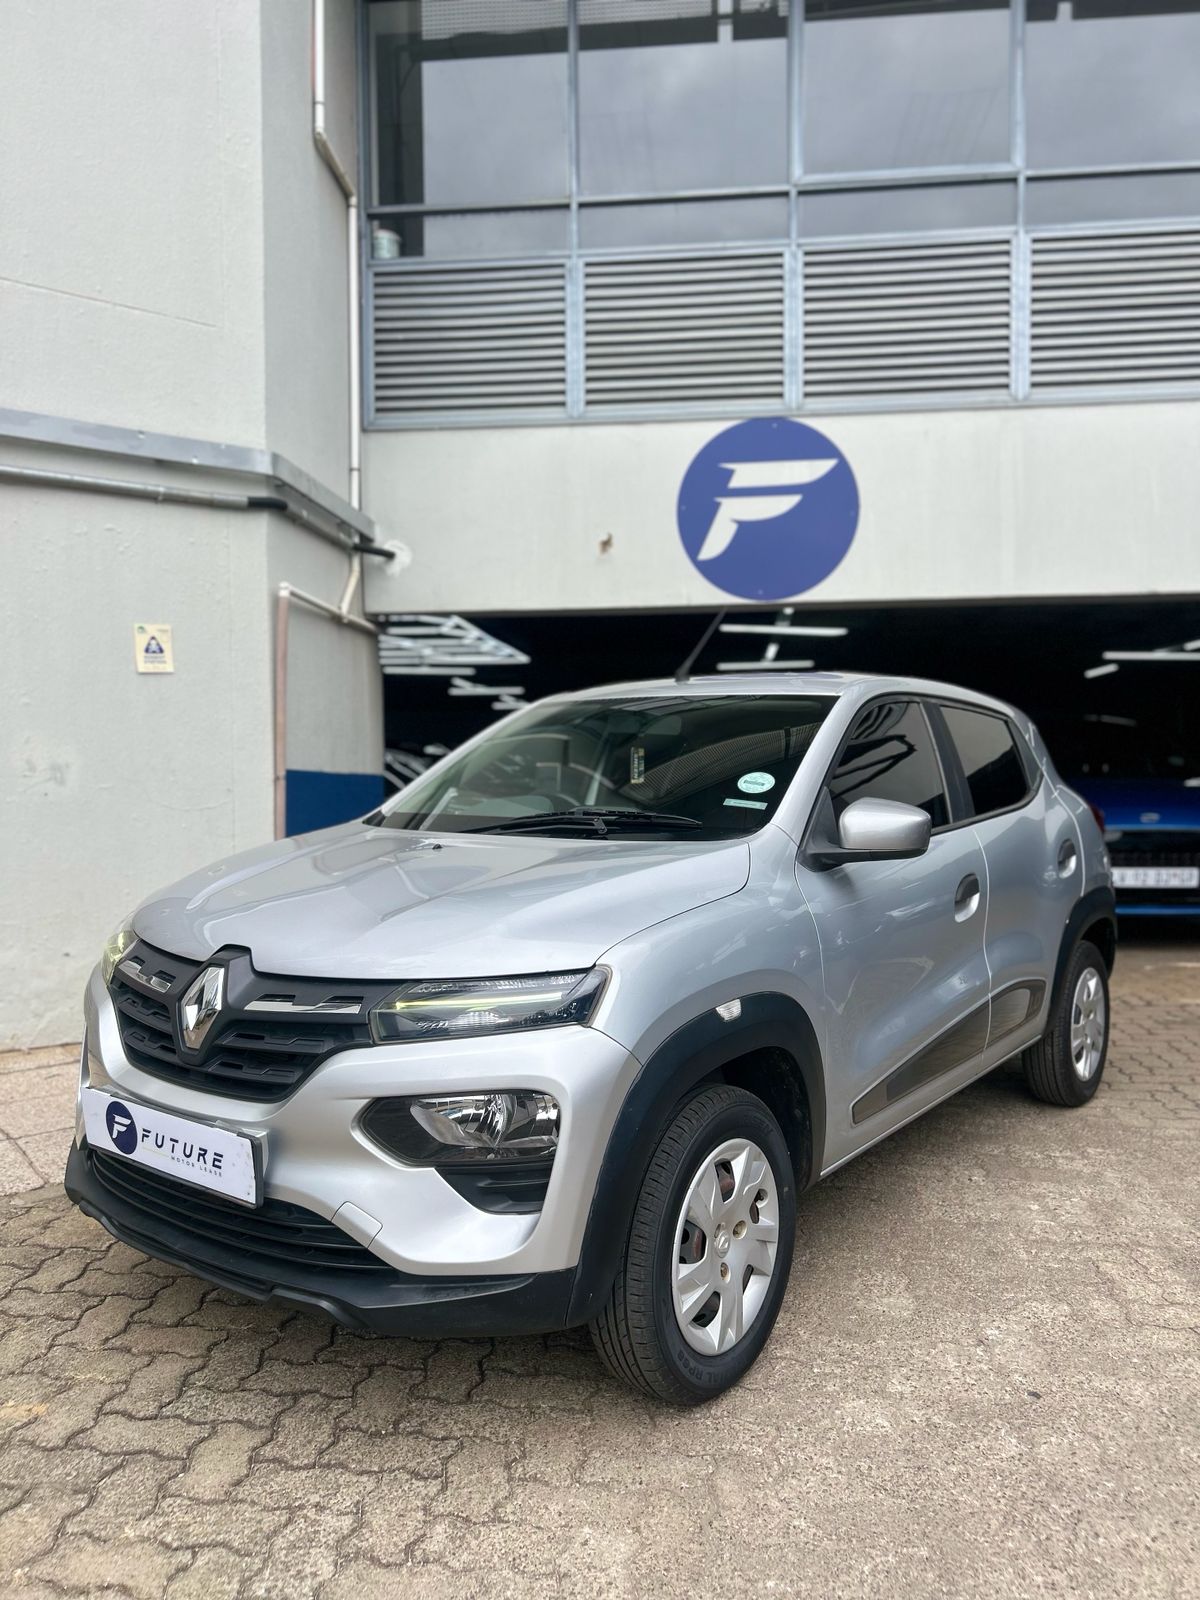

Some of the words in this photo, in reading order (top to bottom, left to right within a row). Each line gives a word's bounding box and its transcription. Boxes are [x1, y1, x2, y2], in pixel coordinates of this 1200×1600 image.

[697, 458, 839, 561] F
[142, 1128, 223, 1169] FUTURE
[171, 1156, 195, 1167] MOTOR
[200, 1165, 222, 1177] LEASE
